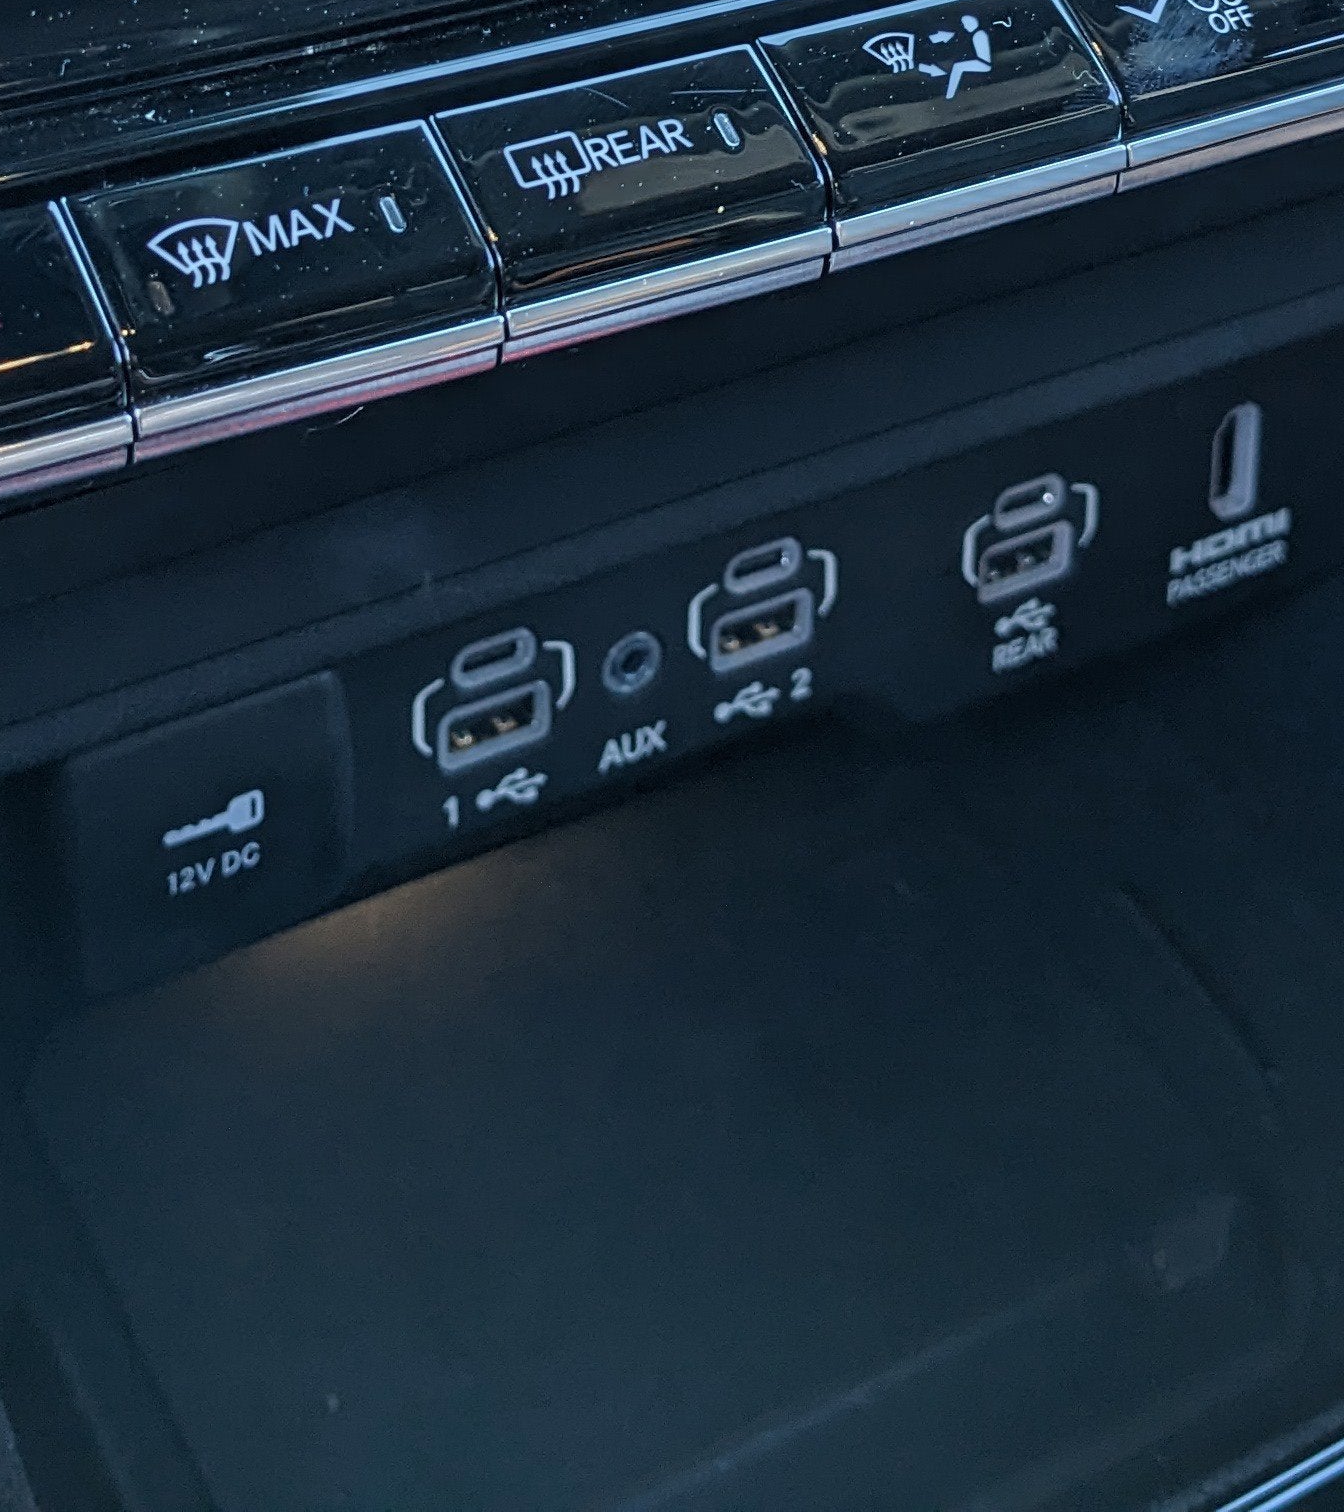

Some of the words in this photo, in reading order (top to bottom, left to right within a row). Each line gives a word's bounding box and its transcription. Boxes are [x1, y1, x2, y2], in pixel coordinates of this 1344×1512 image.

[1207, 4, 1254, 34] OFF
[583, 119, 694, 172] REAR
[242, 198, 355, 256] MAX
[789, 667, 814, 701] 2
[597, 719, 668, 774] AUX
[443, 794, 460, 827] 1
[167, 856, 216, 896] 12V
[221, 841, 261, 878] DC
